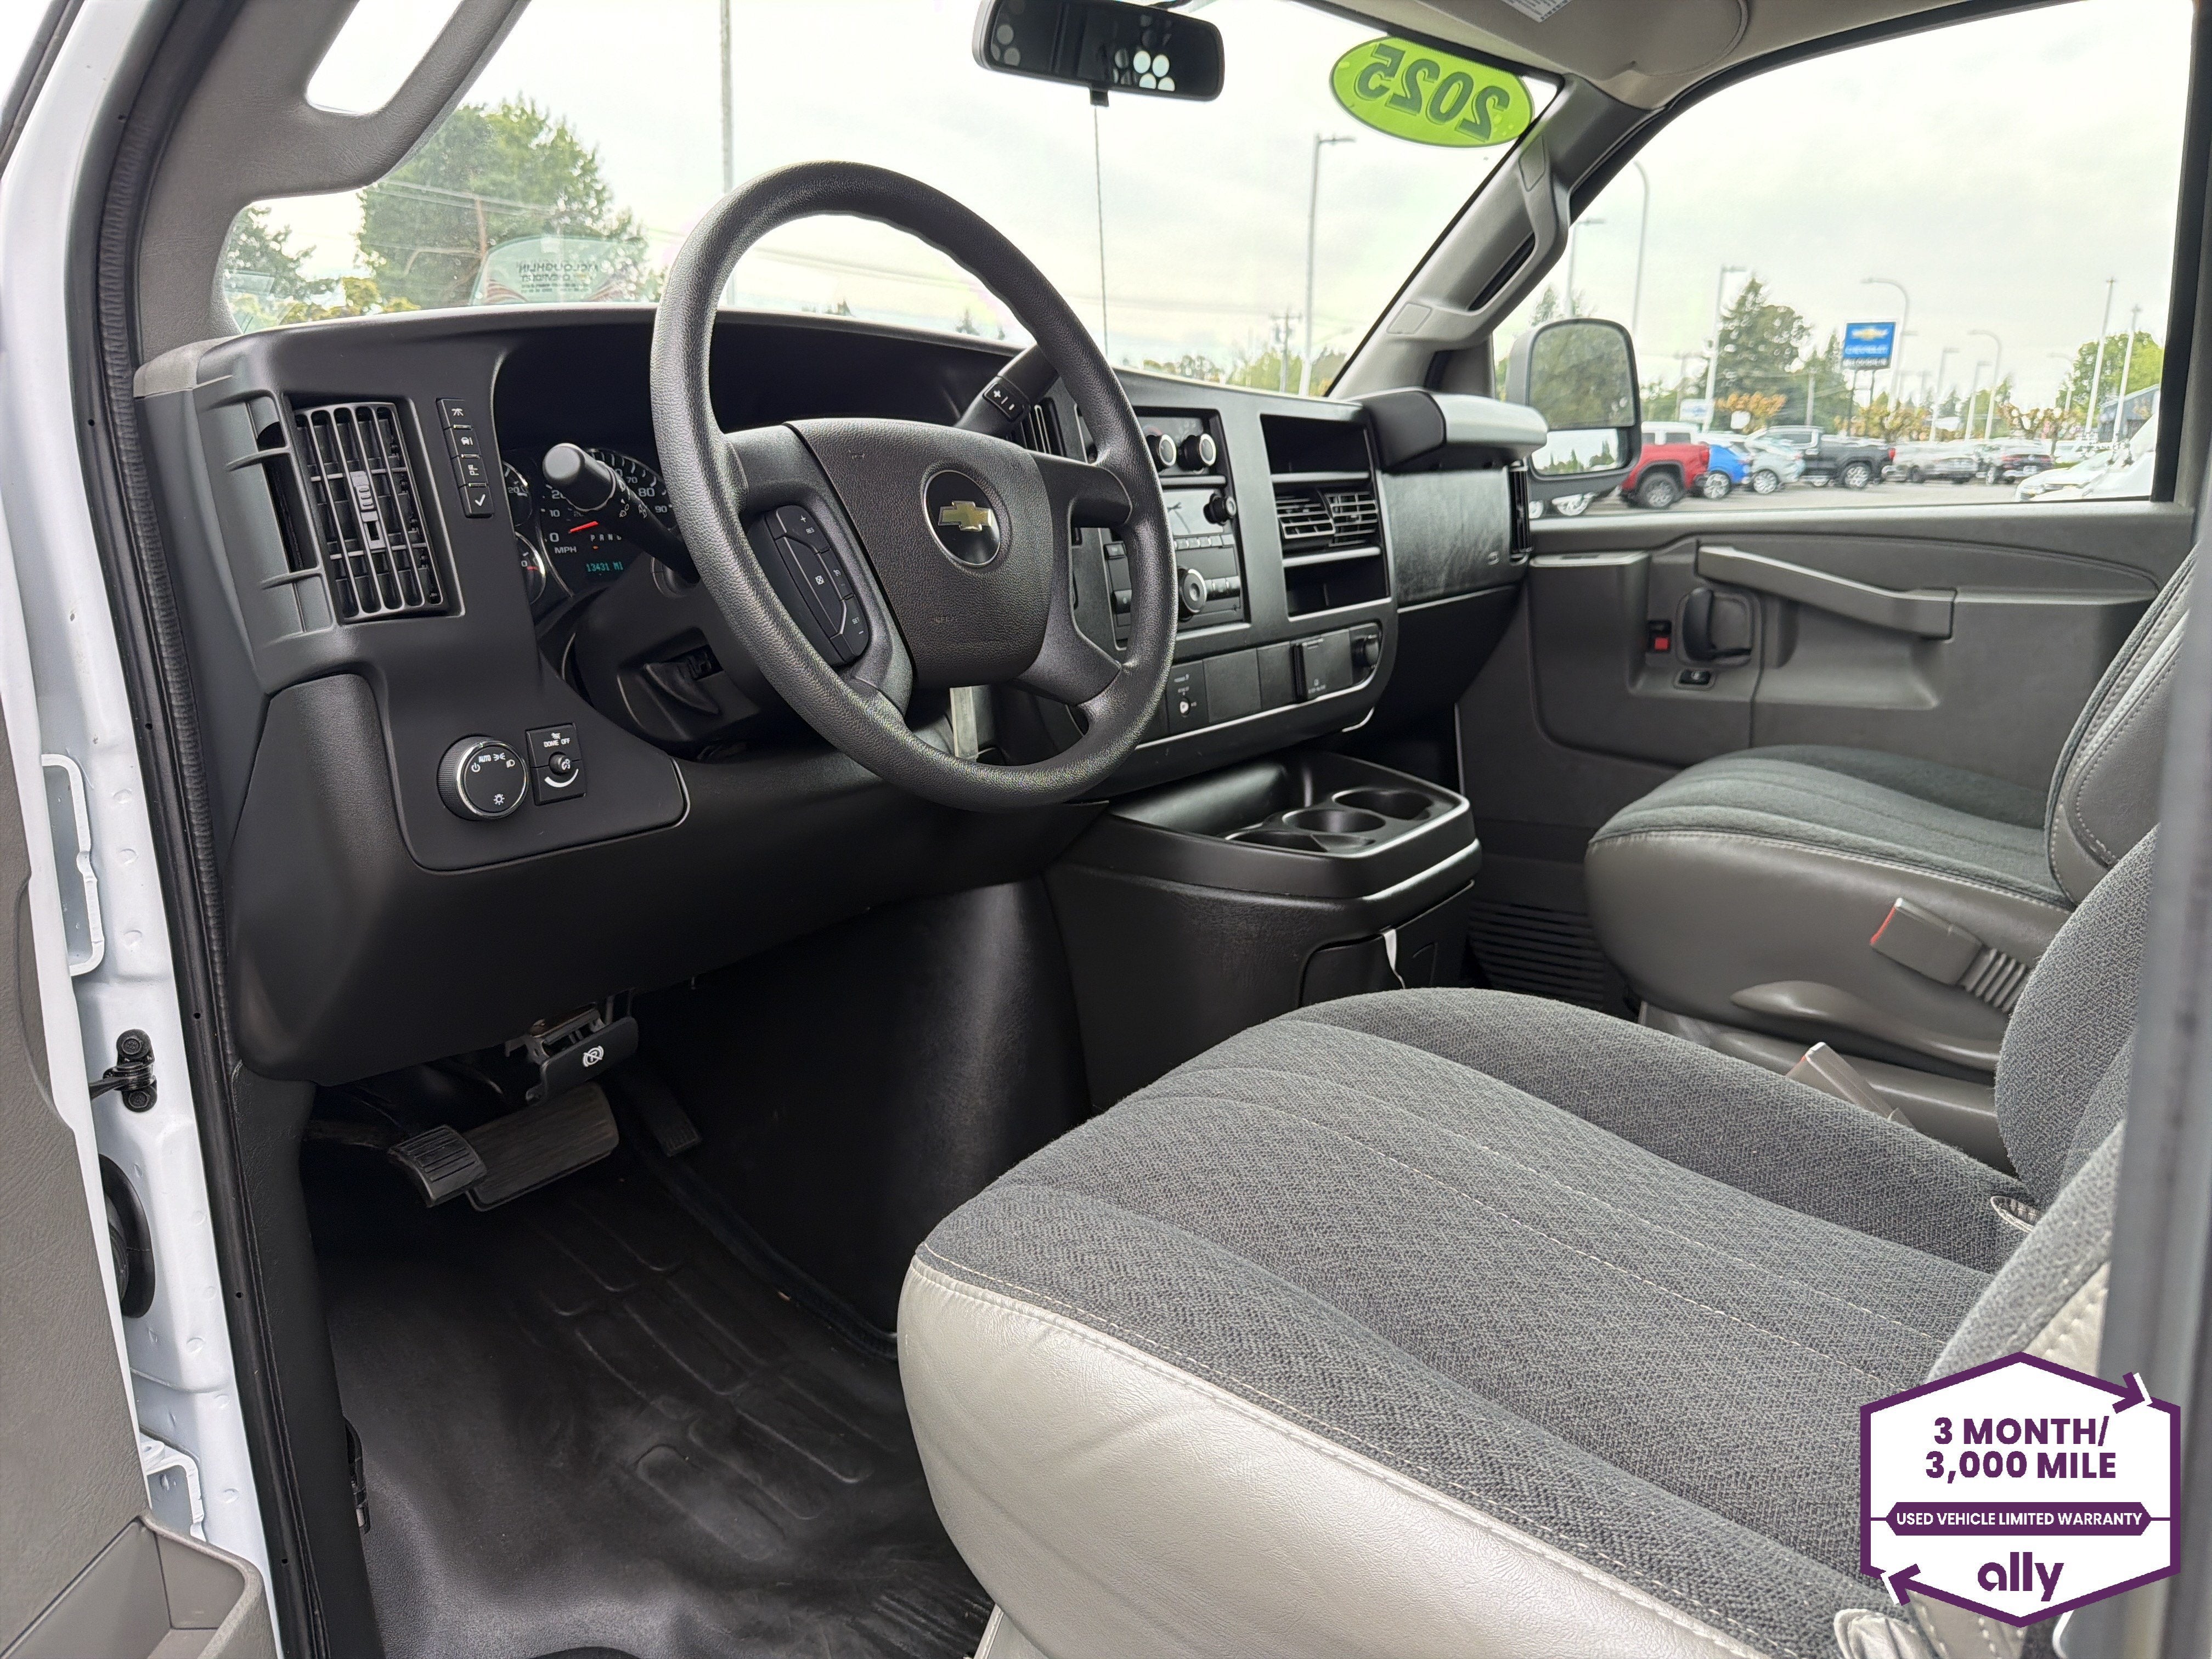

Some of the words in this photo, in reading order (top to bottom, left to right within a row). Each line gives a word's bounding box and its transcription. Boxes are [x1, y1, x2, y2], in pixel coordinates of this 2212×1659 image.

[638, 487, 656, 497] 80
[550, 532, 560, 543] 0
[586, 562, 610, 572] 13431
[852, 617, 860, 625] SET
[544, 740, 560, 748] DOME
[478, 754, 492, 763] AUTO
